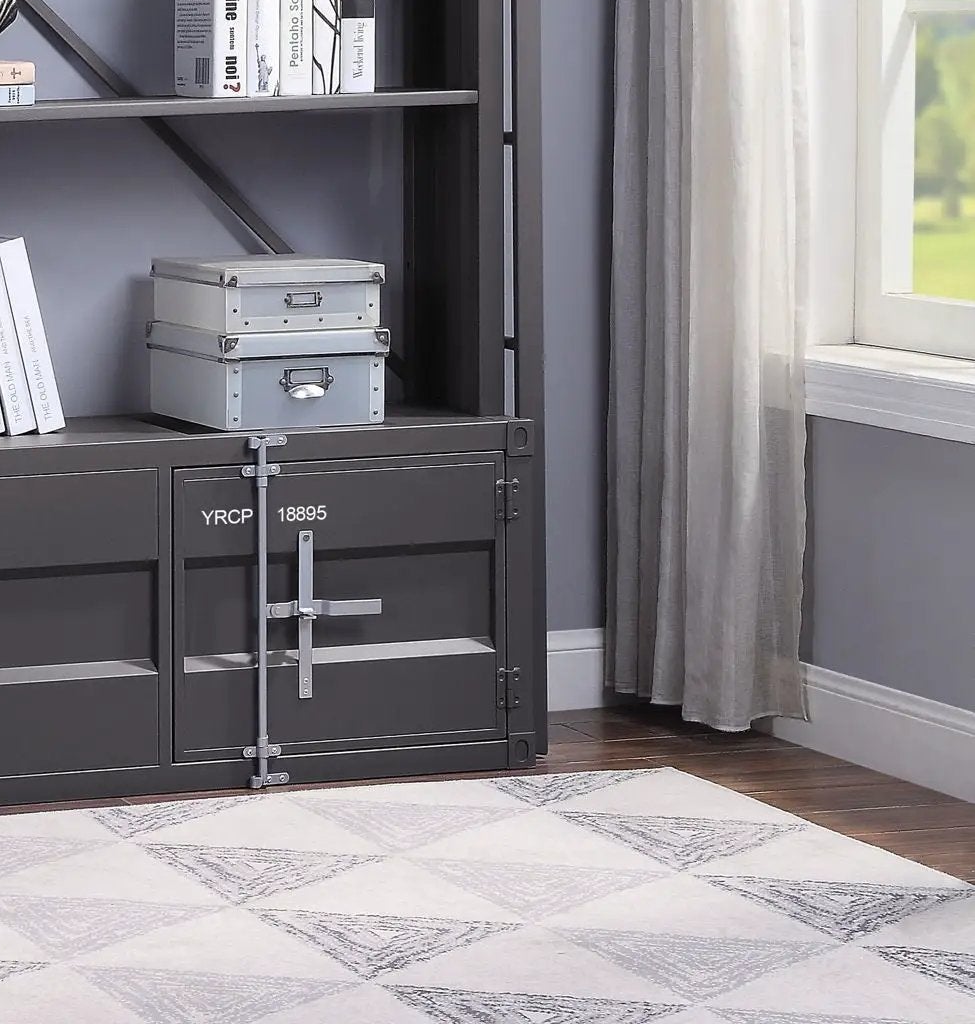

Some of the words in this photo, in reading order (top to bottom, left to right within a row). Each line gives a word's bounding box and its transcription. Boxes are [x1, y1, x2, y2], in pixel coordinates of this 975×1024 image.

[289, 16, 299, 68] Pentaho
[353, 45, 364, 79] Weekend
[3, 361, 14, 382] MAN
[31, 359, 43, 381] MAN
[8, 383, 18, 403] OLD
[37, 381, 47, 401] OLD
[13, 404, 23, 424] THE
[42, 402, 53, 421] THE
[201, 508, 254, 526] YRCP
[277, 505, 328, 522] 18895
